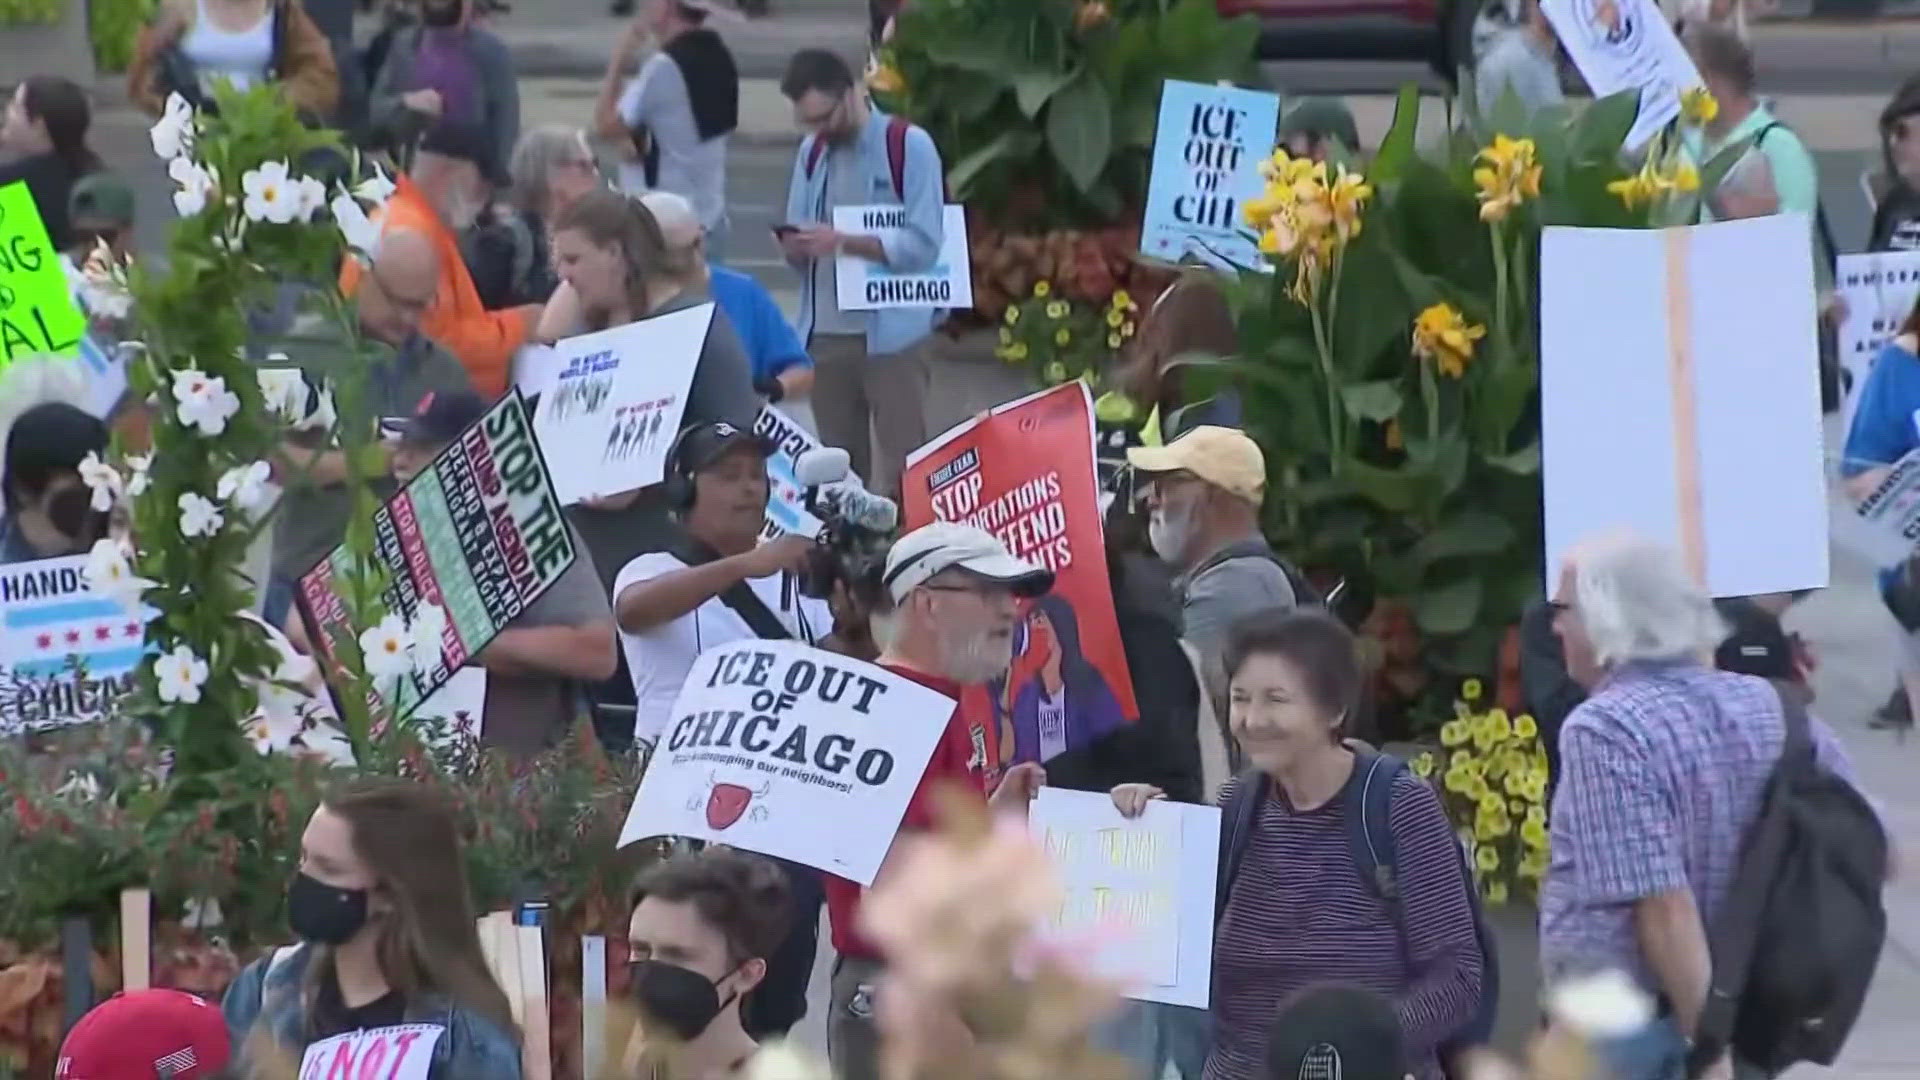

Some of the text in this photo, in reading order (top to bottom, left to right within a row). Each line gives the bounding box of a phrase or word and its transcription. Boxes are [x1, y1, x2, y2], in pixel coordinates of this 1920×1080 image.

[1191, 103, 1247, 143] ICE
[1184, 140, 1245, 171] OUT
[866, 279, 952, 303] CHICAGO
[461, 423, 500, 499] TRUMP
[486, 402, 568, 579] STOP THE
[931, 471, 983, 522] STOP
[374, 505, 403, 570] DEFEND
[392, 491, 416, 538] STOP
[412, 543, 439, 600] POLICE
[436, 453, 509, 630] IMMIGRANT RIGHTS
[449, 442, 480, 515] DEFEND
[480, 541, 522, 618] EXPAND
[996, 501, 1066, 556] EFEND
[706, 650, 888, 715] ICE OUT
[751, 689, 797, 715] OF
[668, 710, 895, 786] CHICAGO
[757, 761, 779, 774] our
[327, 1031, 422, 1080] NOT
